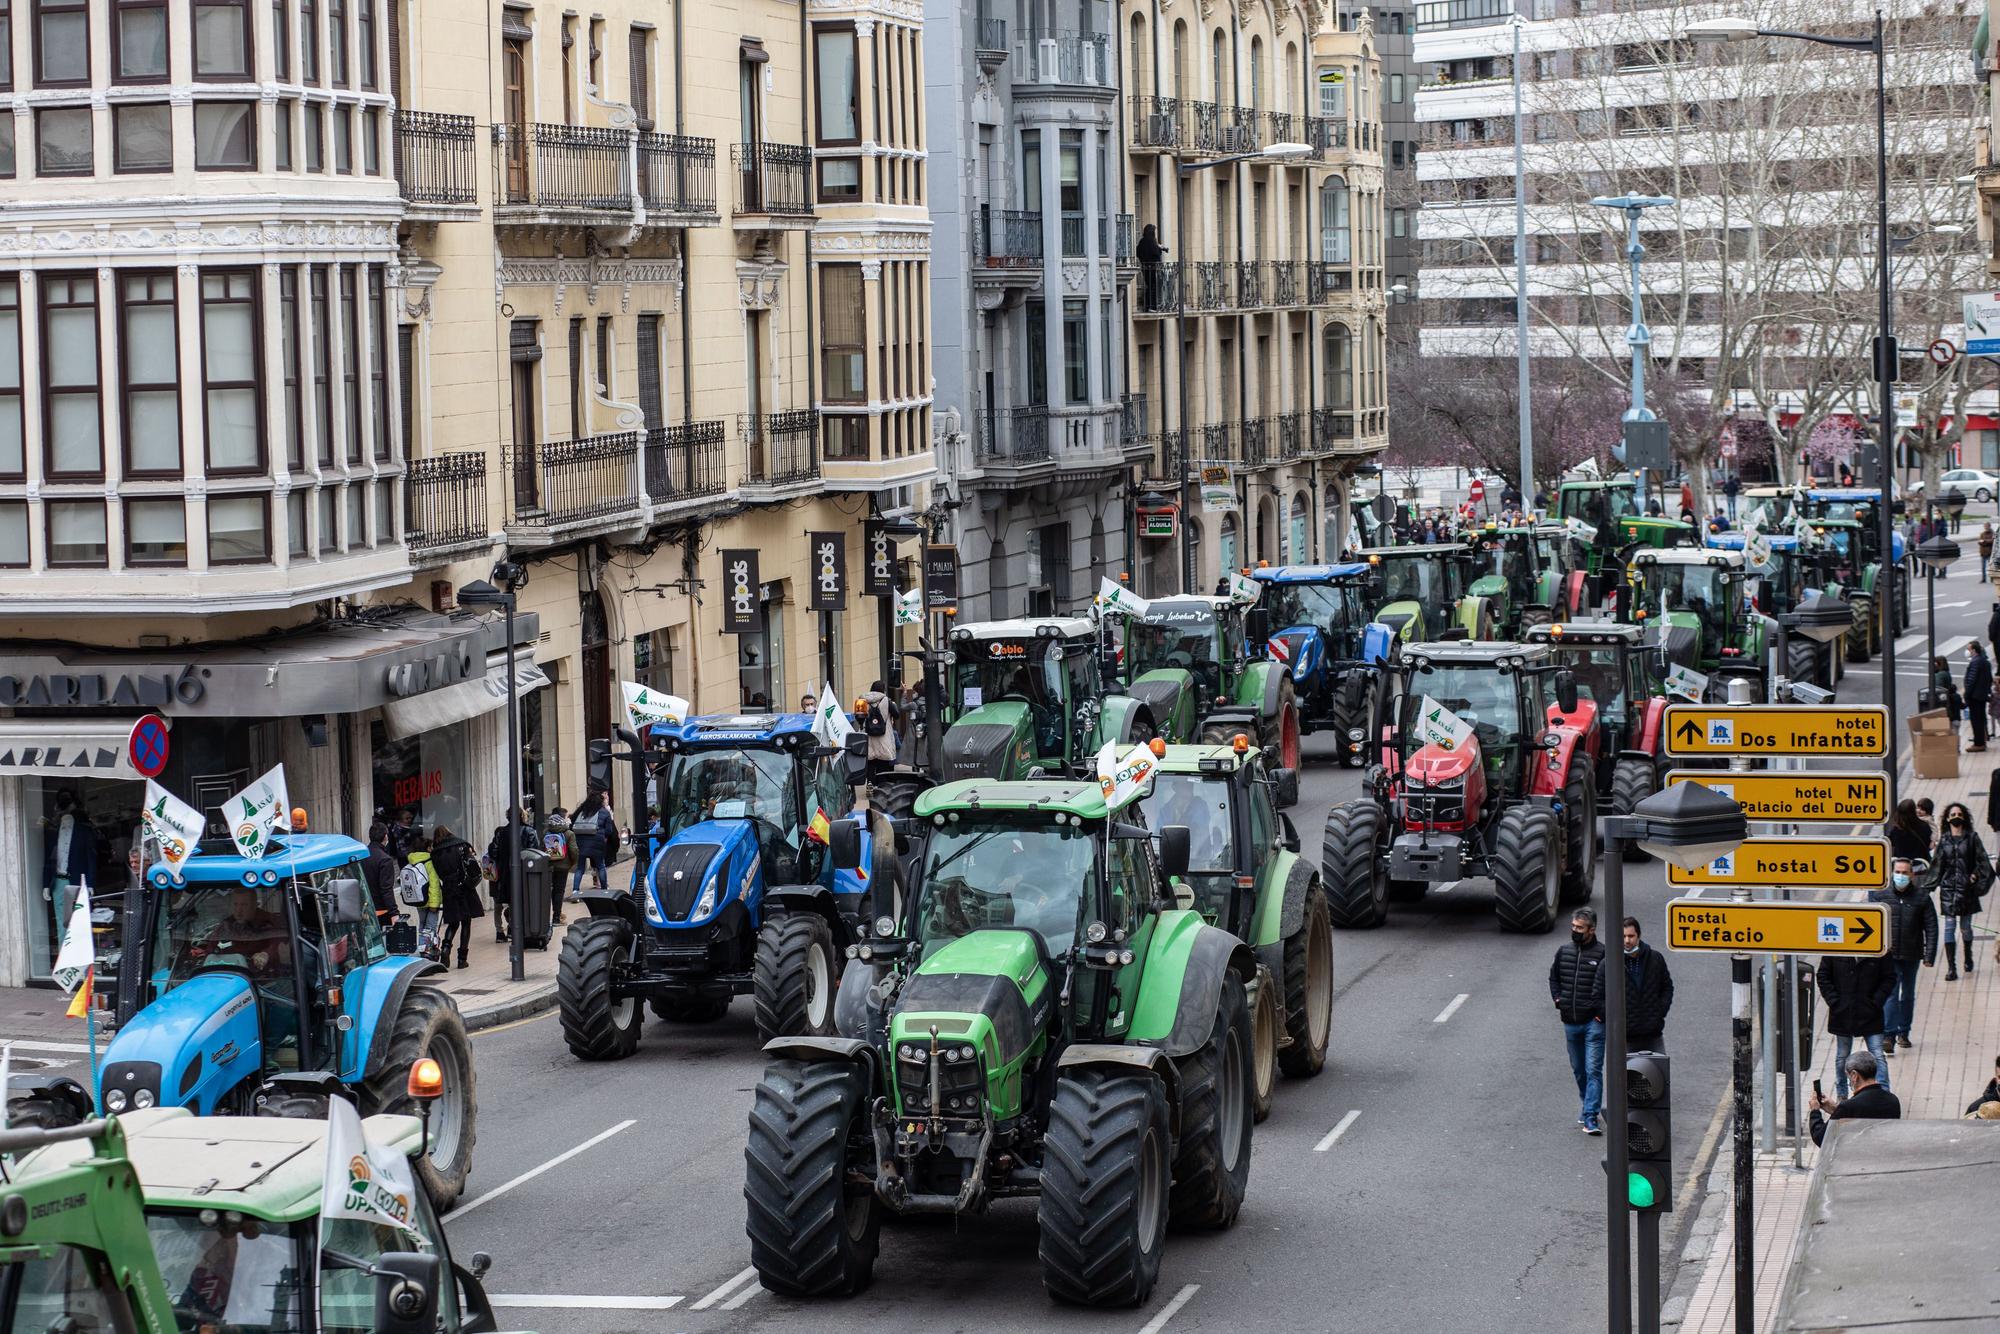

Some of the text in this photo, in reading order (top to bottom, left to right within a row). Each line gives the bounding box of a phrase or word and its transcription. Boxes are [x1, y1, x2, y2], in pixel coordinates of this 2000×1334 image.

[1143, 612, 1164, 624] ranja
[646, 700, 672, 710] ASAJA
[1836, 718, 1876, 729] hotel
[1740, 732, 1877, 748] Dos Infantas
[395, 769, 442, 806] REBAJAS
[1795, 784, 1878, 799] hotel NH
[1740, 801, 1877, 814] Palacio del Duero
[162, 814, 185, 834] ASAJA
[244, 843, 265, 859] UPA
[1757, 855, 1877, 874] hostal Sol
[1678, 912, 1728, 924] hostal
[1679, 926, 1764, 943] Trefacio
[61, 967, 80, 987] UPA
[31, 1193, 88, 1220] DEUTZ-FAHR
[344, 1193, 378, 1215] UPA
